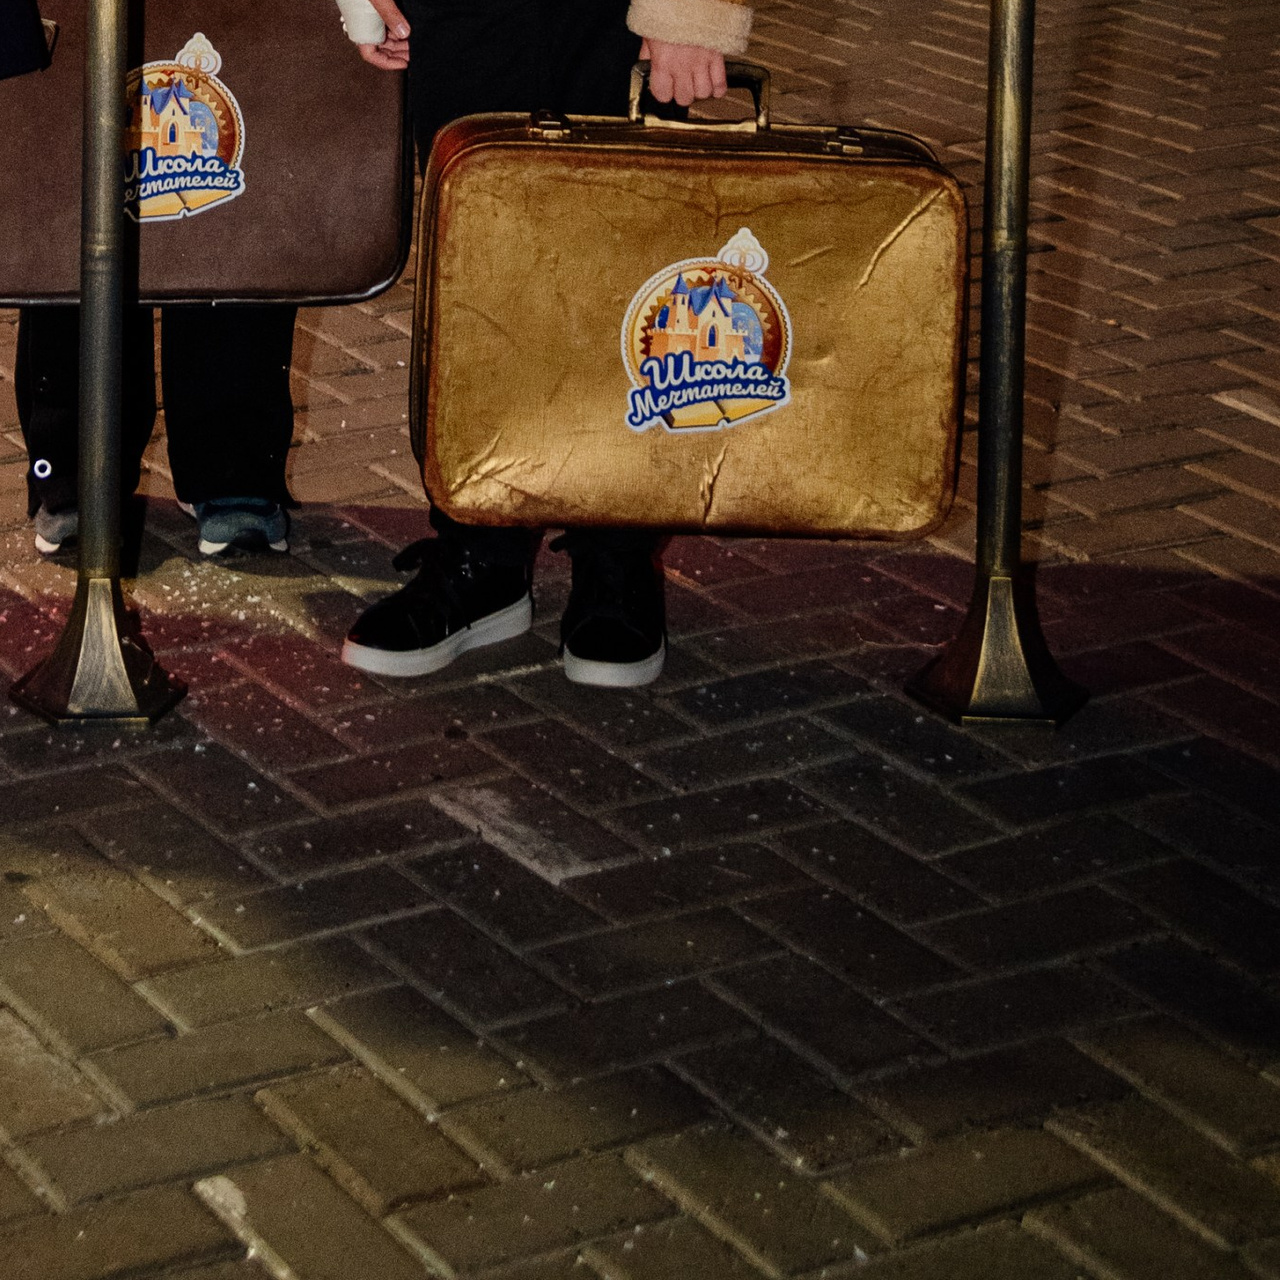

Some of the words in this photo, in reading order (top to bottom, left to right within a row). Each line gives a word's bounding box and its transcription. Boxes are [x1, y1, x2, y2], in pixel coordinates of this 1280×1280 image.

[123, 148, 224, 183] Школа
[123, 172, 238, 204] ечтателей
[642, 352, 768, 389] Школа
[630, 380, 783, 424] Мечтателей
